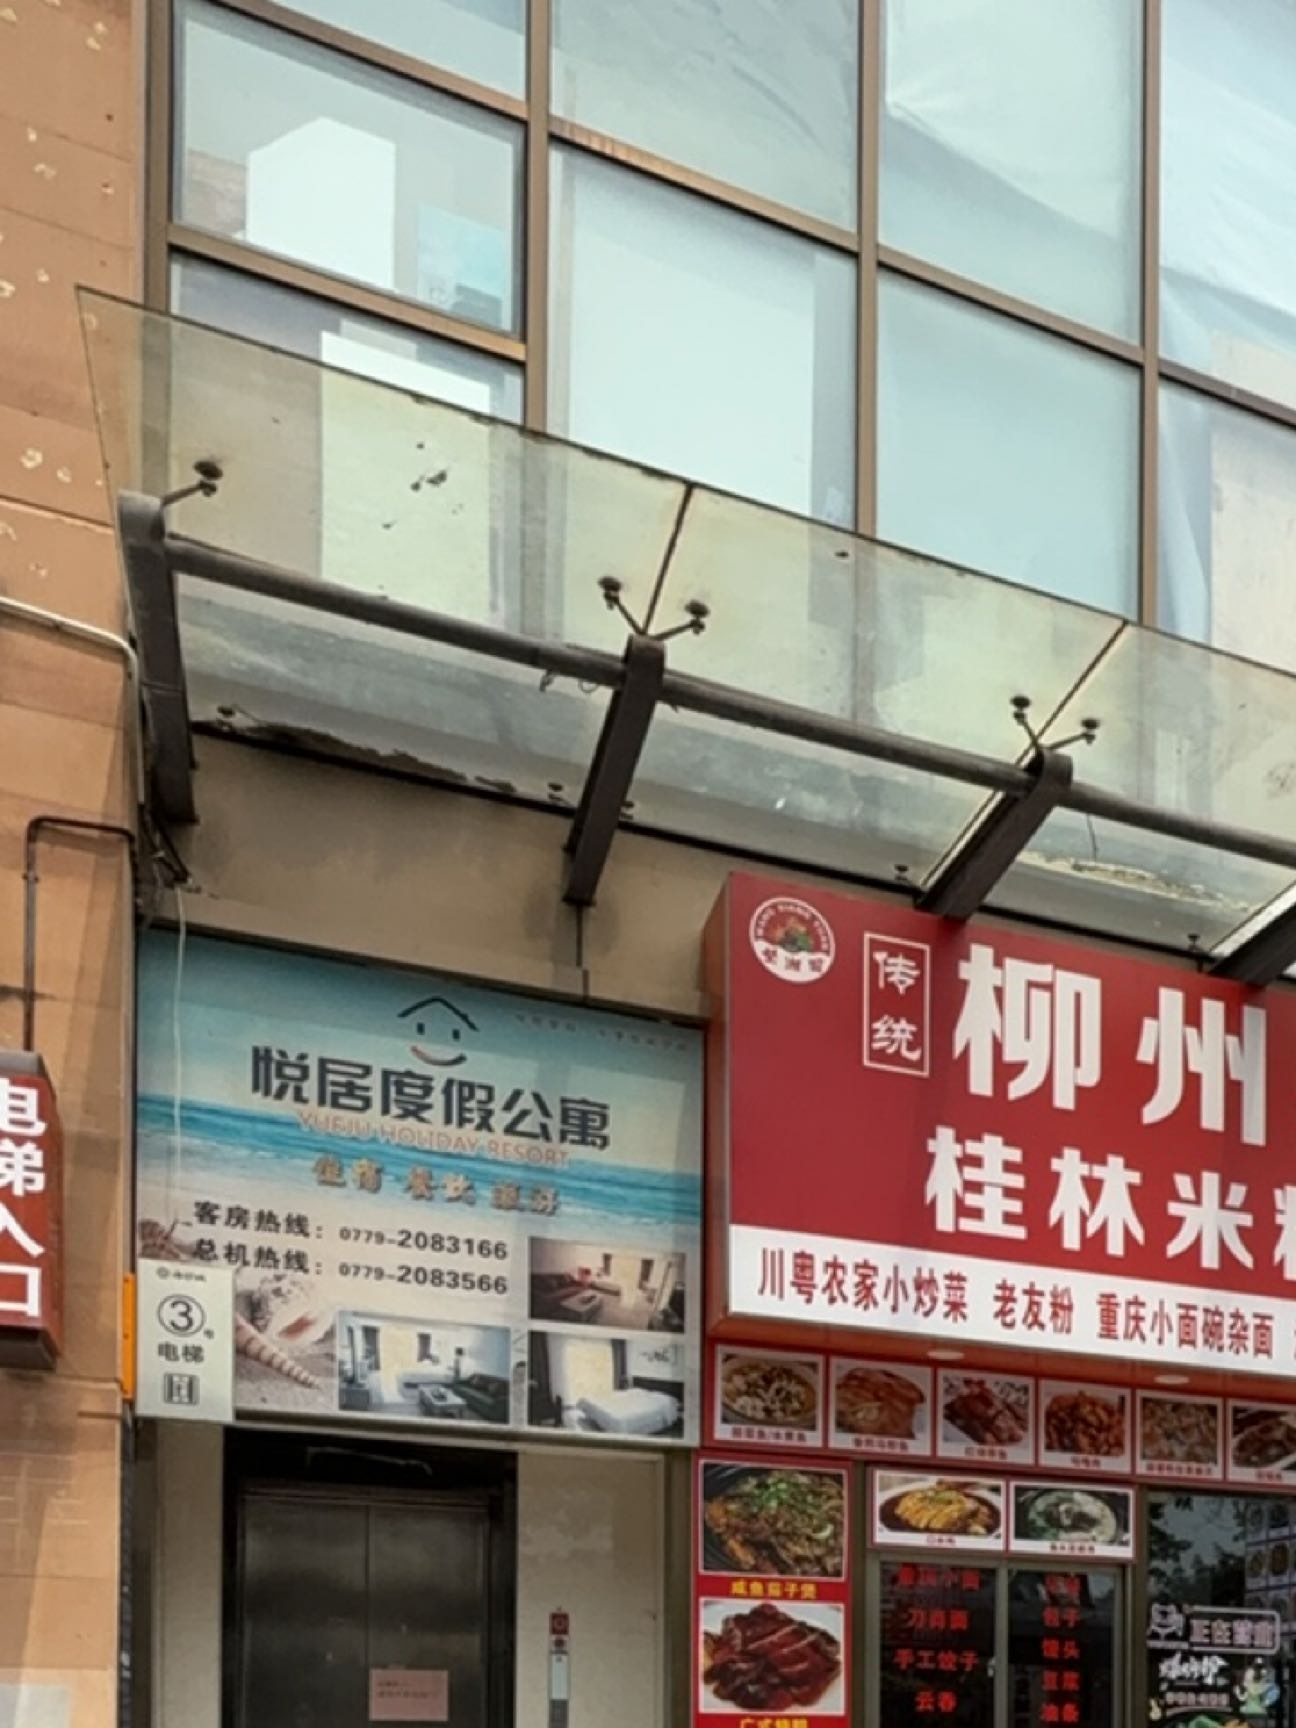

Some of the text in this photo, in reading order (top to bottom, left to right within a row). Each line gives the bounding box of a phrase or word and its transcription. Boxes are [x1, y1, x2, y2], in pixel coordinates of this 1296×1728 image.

[871, 949, 922, 1061] 传统
[249, 1044, 610, 1151] 悦居度假公寓
[386, 1122, 480, 1153] HOLIDAY
[487, 1138, 571, 1165] RESORT
[338, 1227, 509, 1261] 0779-2083166
[337, 1263, 509, 1296] 0779-2083566
[757, 1247, 968, 1324] 川粤农家小炒菜
[992, 1278, 1075, 1336] 老友粉
[1096, 1292, 1275, 1359] 重庆小面碗杂面
[157, 1341, 205, 1366] 电梯
[730, 1580, 818, 1600] 咸鱼茄子煲
[894, 1649, 980, 1672] 手工饺子
[1043, 1671, 1080, 1691] 豆浆
